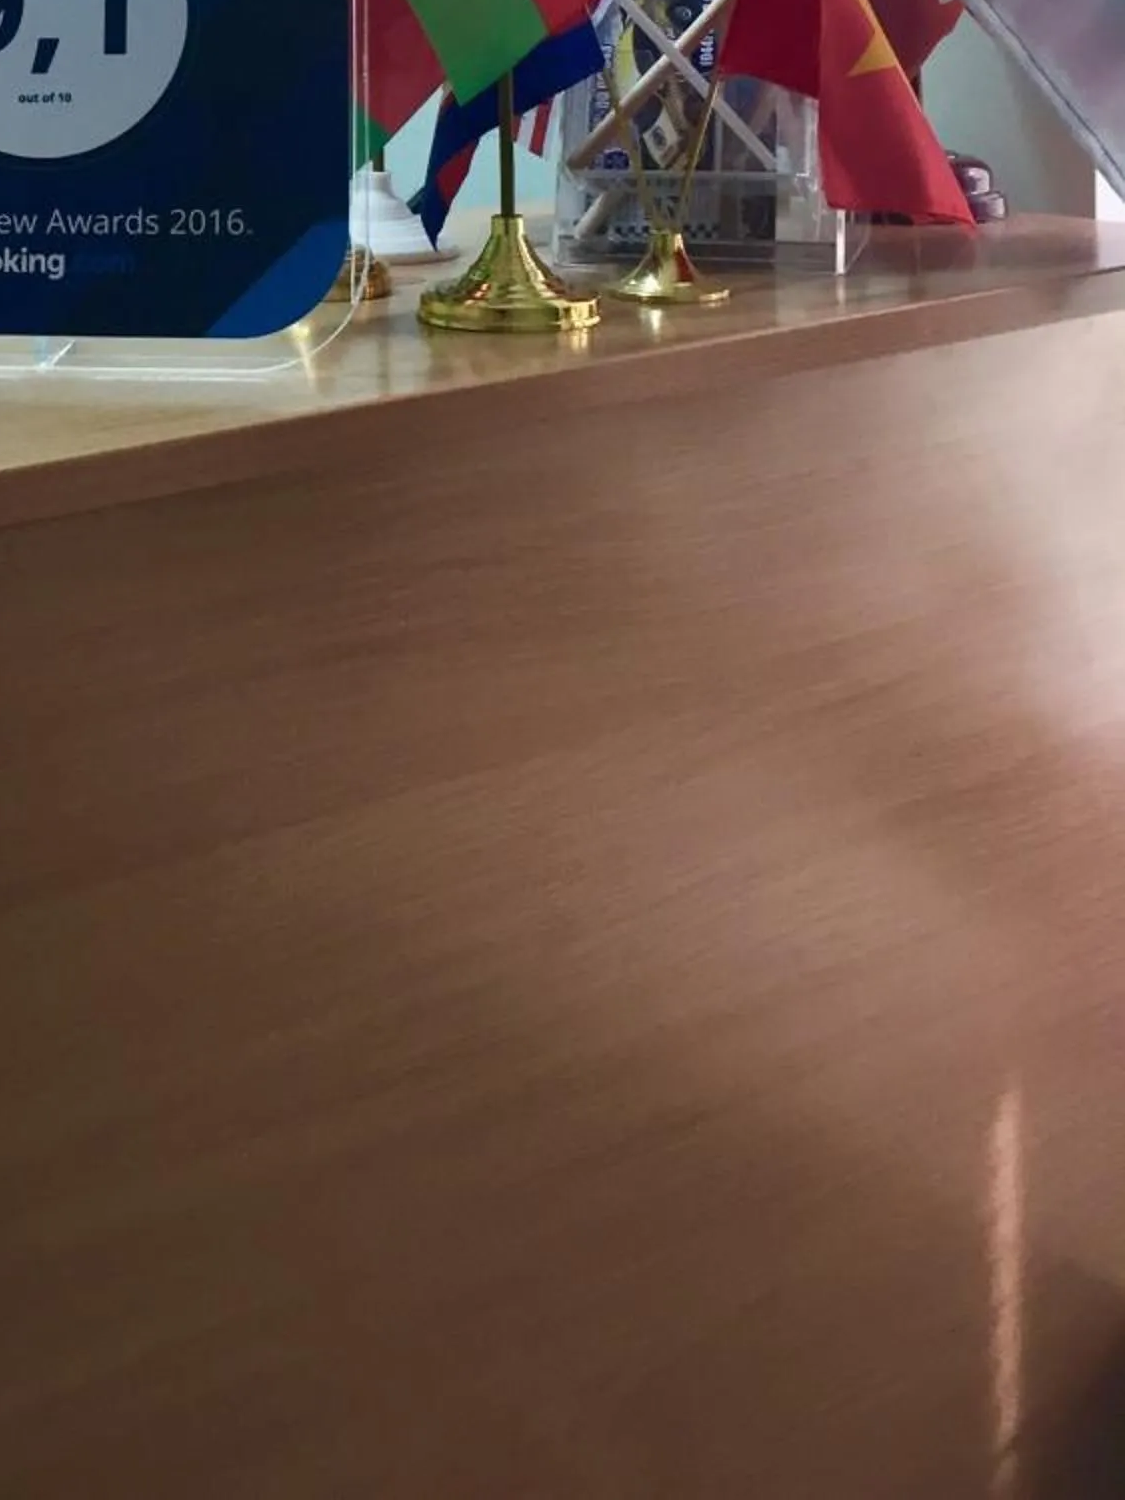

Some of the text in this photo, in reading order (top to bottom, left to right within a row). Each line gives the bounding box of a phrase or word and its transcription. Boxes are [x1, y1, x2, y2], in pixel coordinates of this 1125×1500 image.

[18, 91, 72, 104] out of 10
[45, 206, 160, 236] Awards
